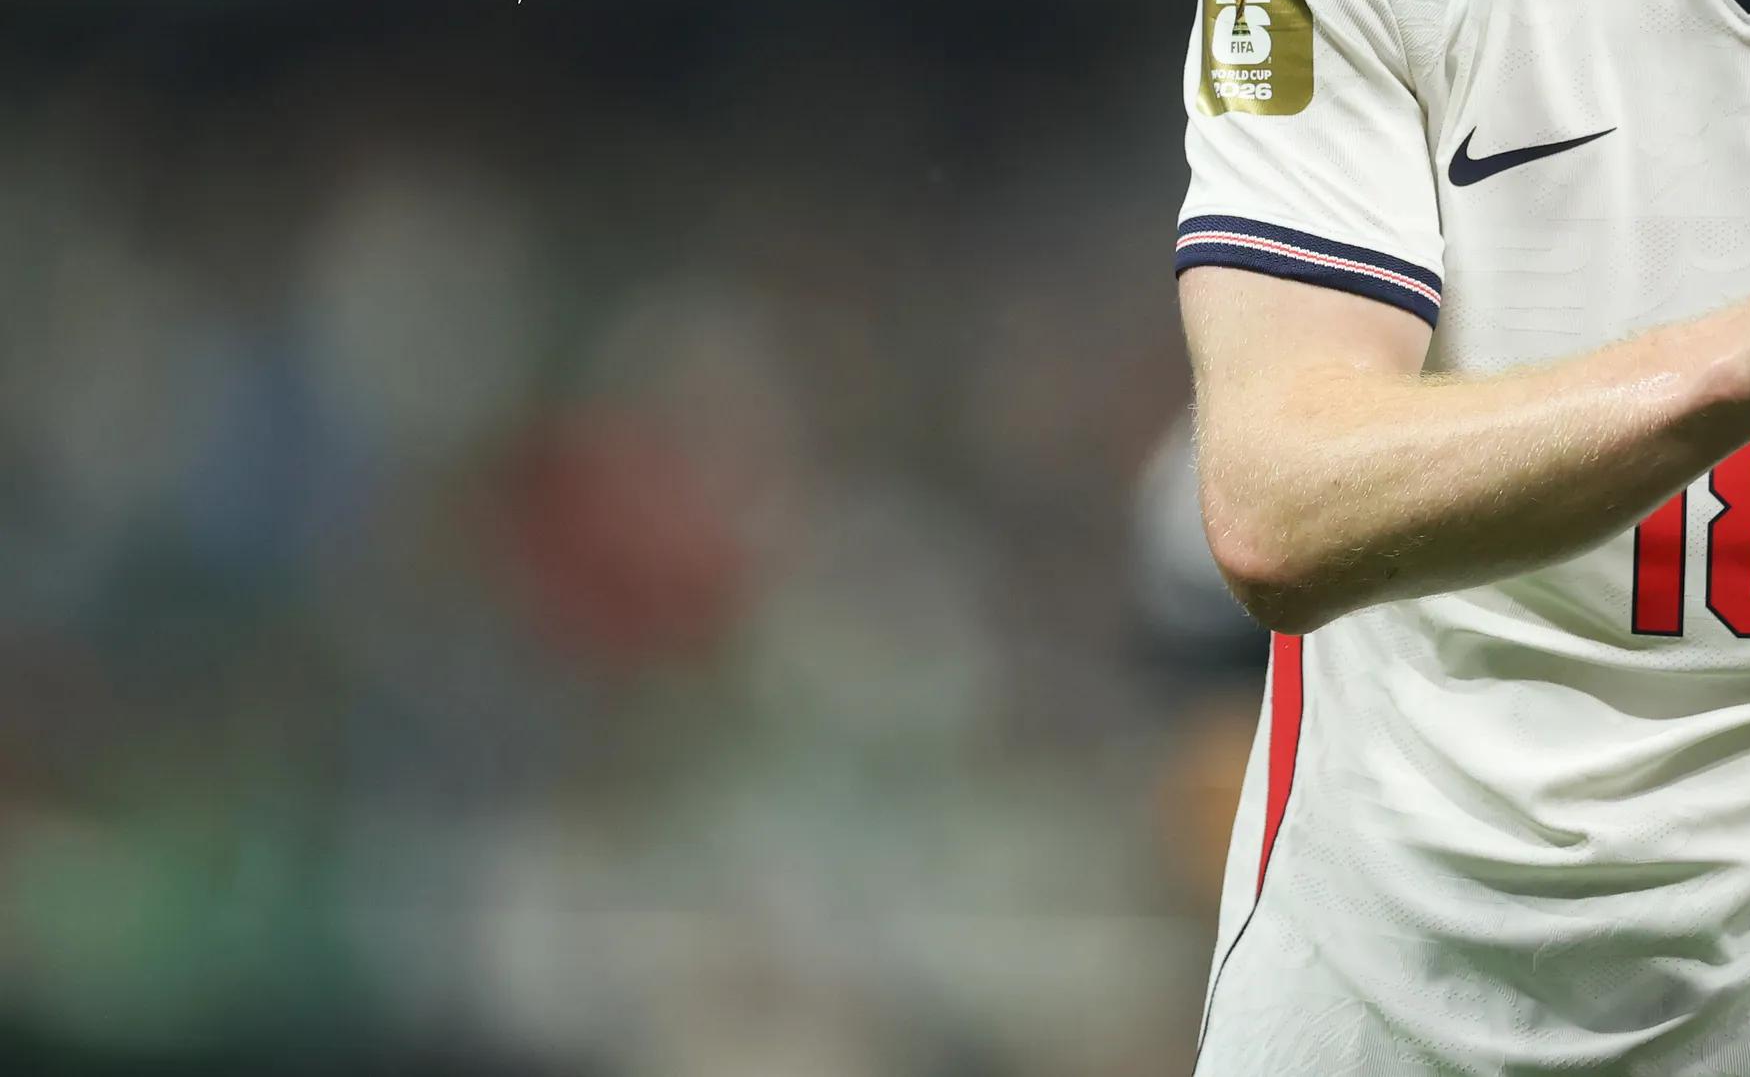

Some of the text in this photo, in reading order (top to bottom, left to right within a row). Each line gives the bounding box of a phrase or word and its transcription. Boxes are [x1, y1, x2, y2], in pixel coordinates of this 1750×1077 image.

[1231, 41, 1254, 53] FIFA
[1211, 69, 1273, 81] WORLD CUP
